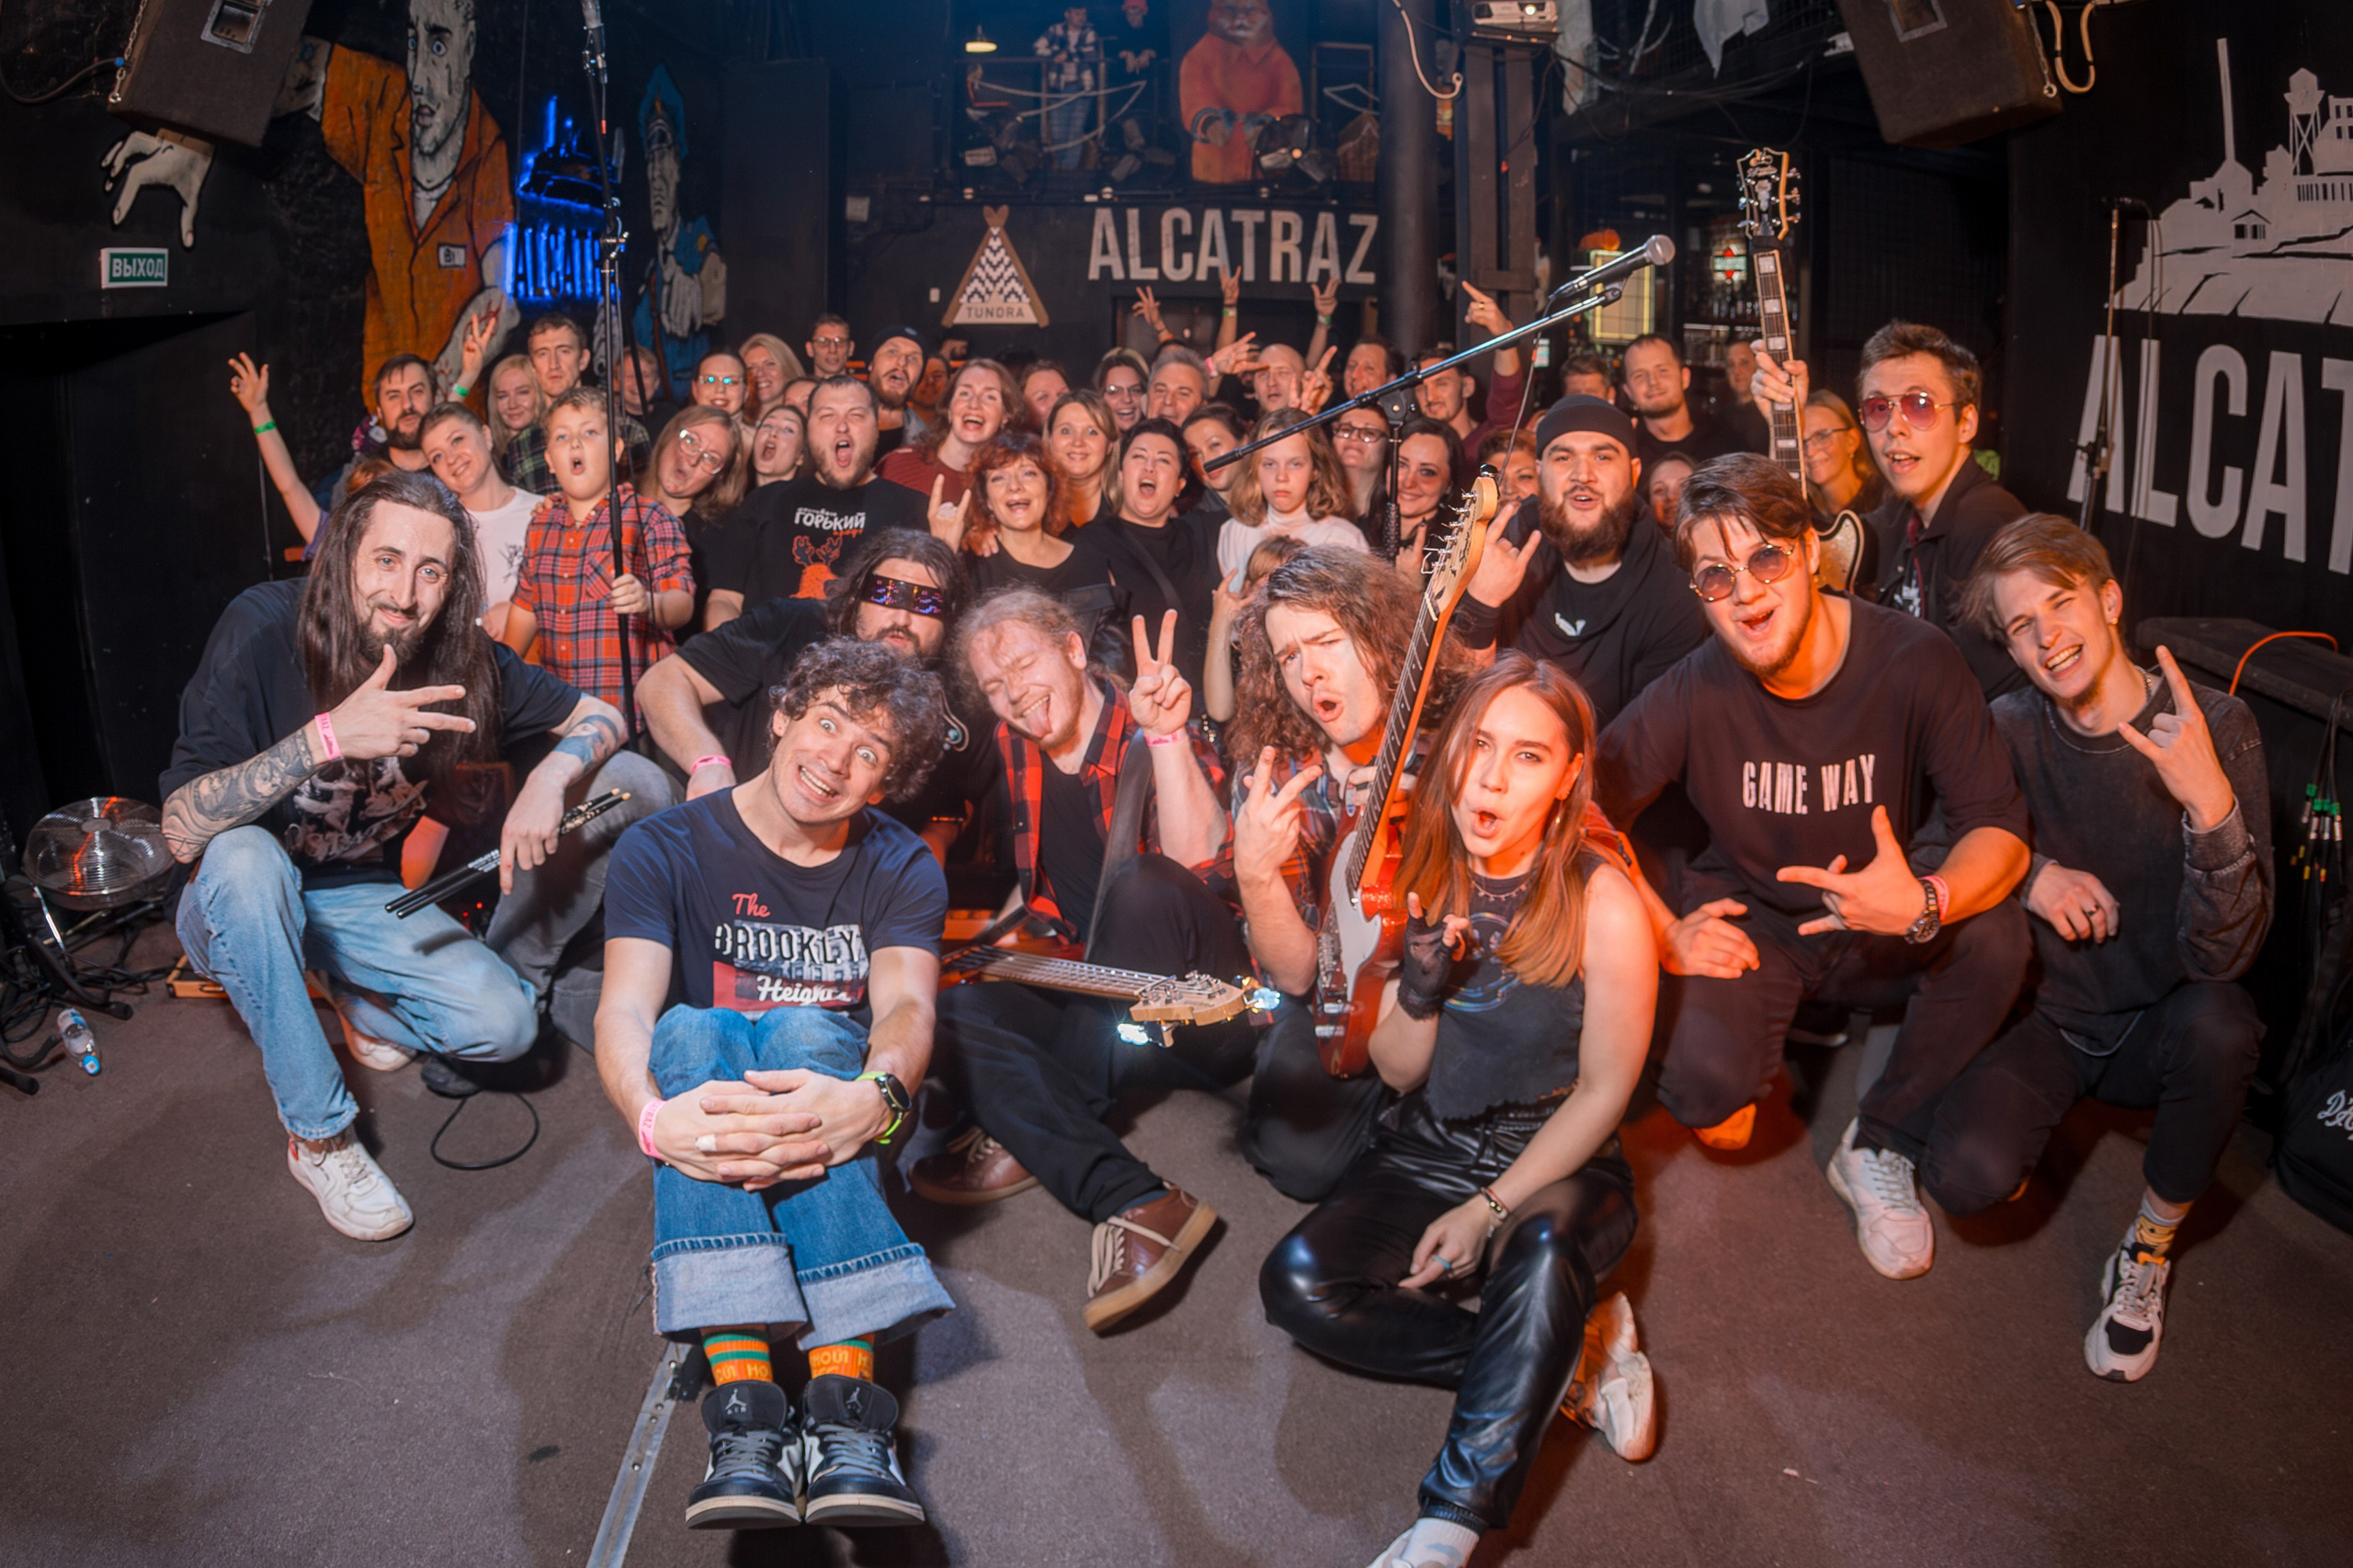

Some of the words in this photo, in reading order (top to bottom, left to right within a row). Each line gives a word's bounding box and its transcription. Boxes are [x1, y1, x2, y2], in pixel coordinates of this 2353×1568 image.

[511, 223, 626, 301] ALCATR
[1087, 207, 1379, 284] ALCATRAZ
[112, 257, 165, 278] ВЫХОД
[966, 306, 1026, 319] TUNDRA
[793, 511, 867, 530] ГОРЬКИЙ
[1742, 760, 1808, 815] GAME
[1821, 754, 1876, 812] WAY
[732, 892, 770, 917] The
[714, 922, 861, 965] BROOKLY
